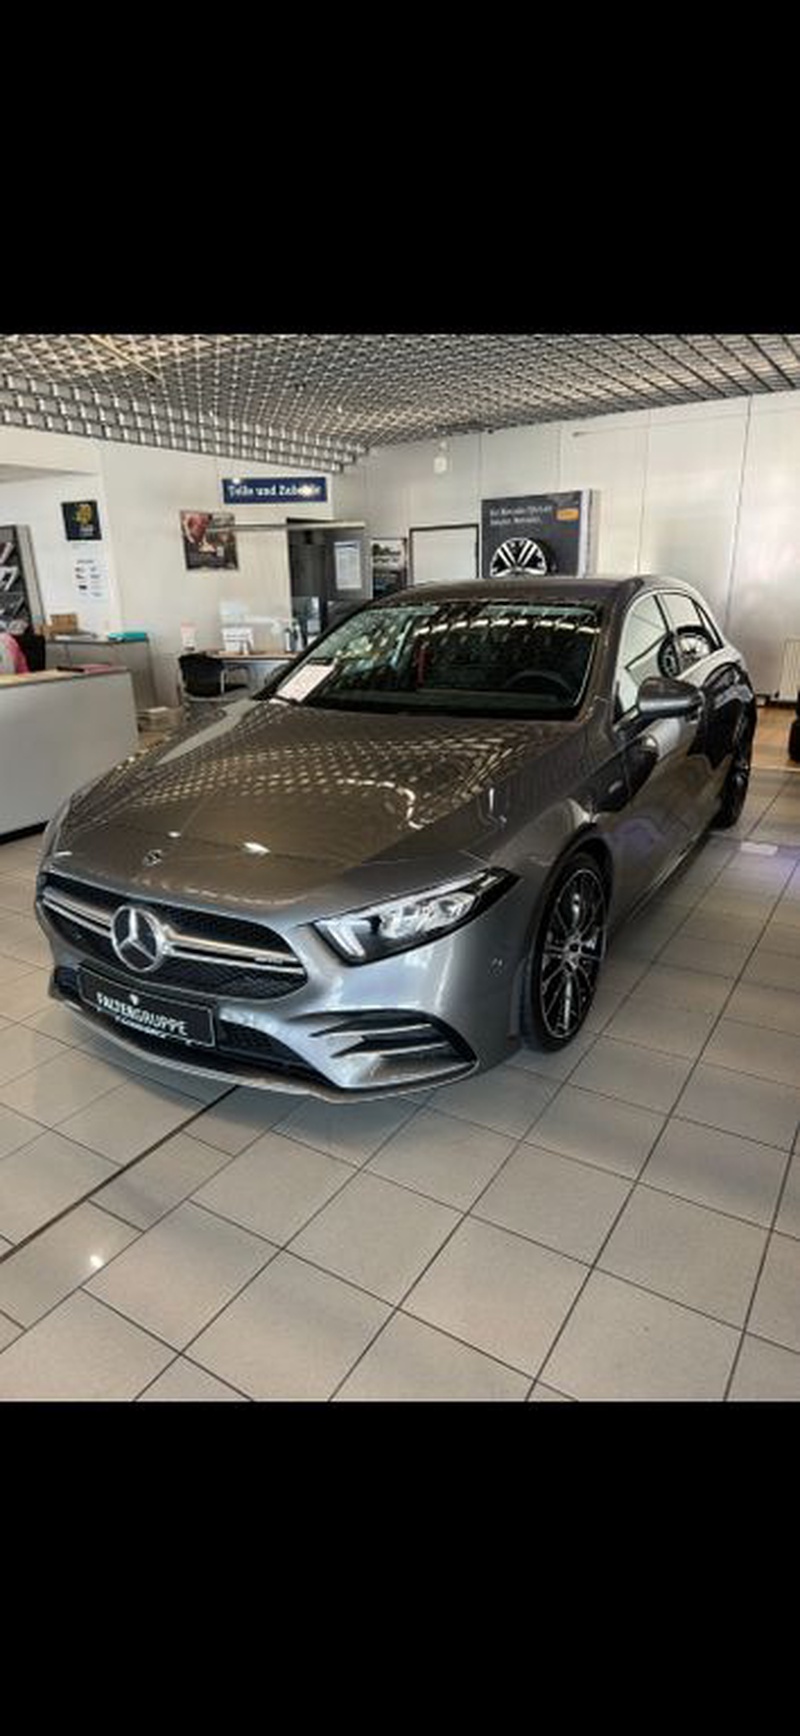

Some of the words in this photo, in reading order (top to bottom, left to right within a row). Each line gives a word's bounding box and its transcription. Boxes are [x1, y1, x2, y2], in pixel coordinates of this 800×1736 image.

[227, 485, 254, 497] Teile
[255, 485, 277, 496] und
[279, 484, 322, 497] Zuber
